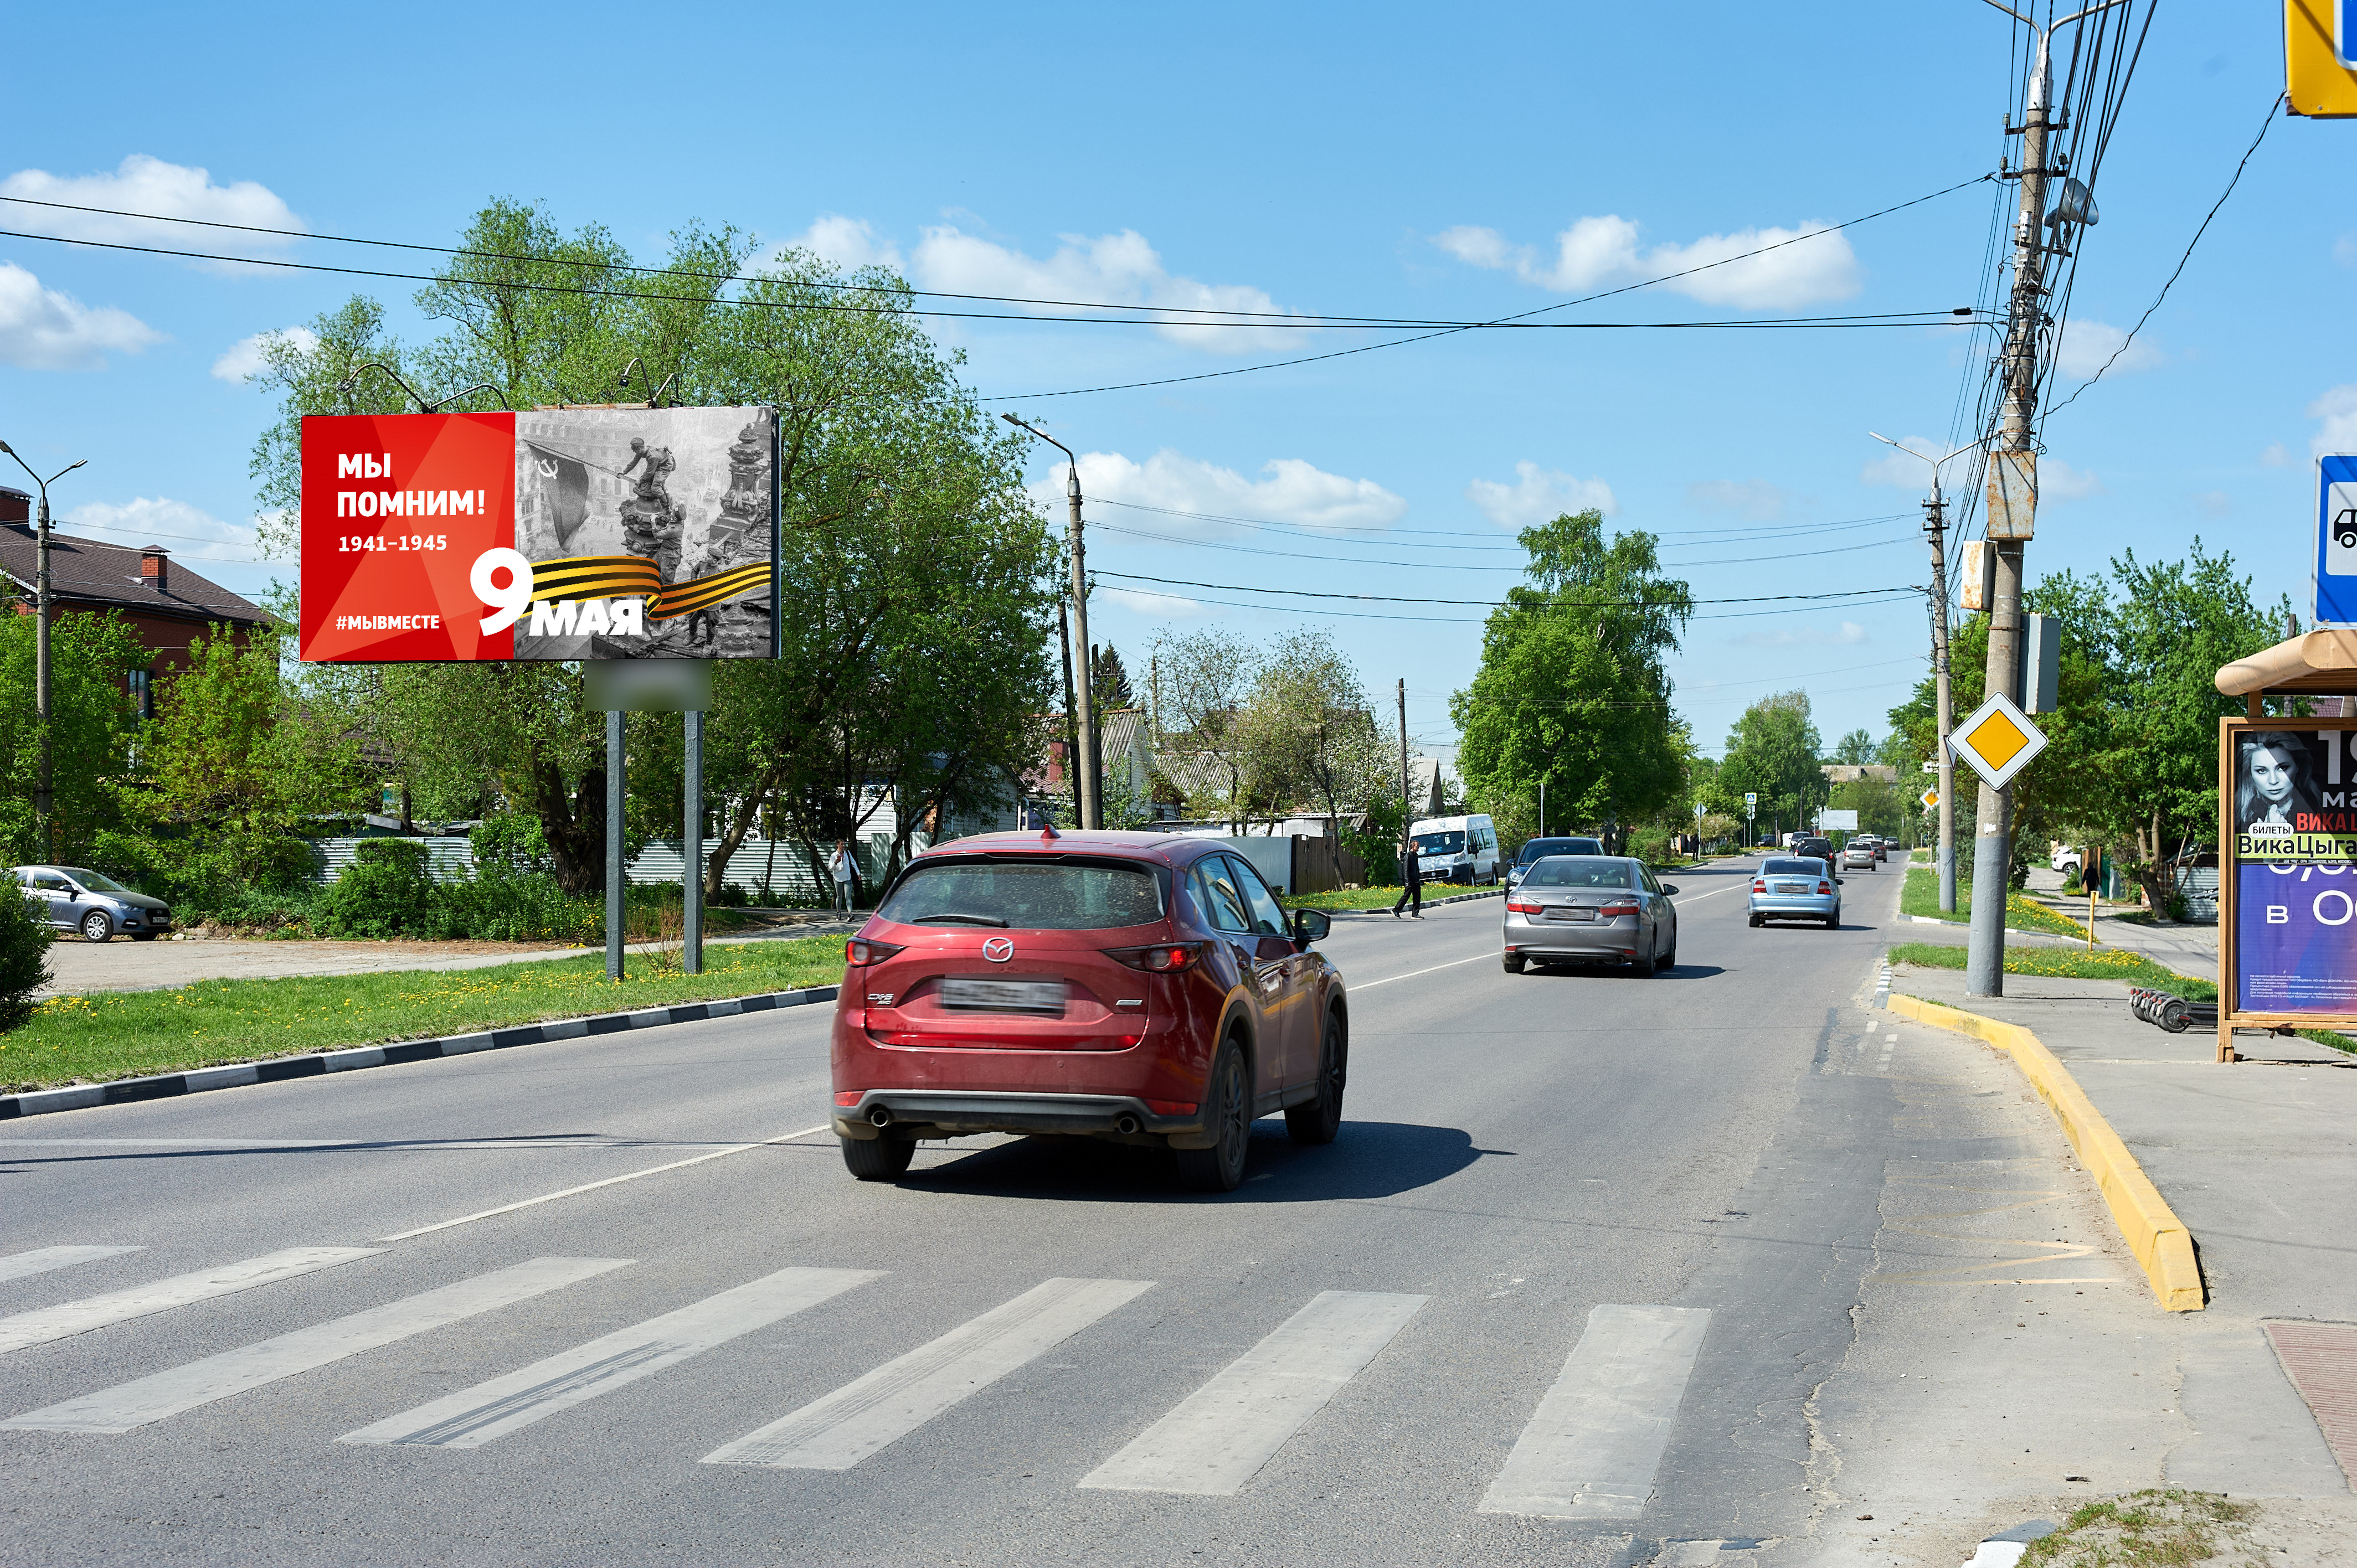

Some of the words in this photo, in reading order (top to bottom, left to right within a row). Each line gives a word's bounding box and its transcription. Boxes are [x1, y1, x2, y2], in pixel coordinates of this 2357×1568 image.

[338, 453, 391, 478] МЫ
[337, 489, 485, 517] ПОМНИМ!
[470, 548, 534, 636] 9
[529, 599, 643, 636] МАЯ
[336, 615, 440, 630] #МЫВМЕСТЕ
[2252, 826, 2291, 834] БИЛЕТЫ
[2296, 812, 2346, 831] ВИКА
[2238, 835, 2357, 858] ВикаЦыга
[2267, 905, 2288, 924] в
[2313, 890, 2357, 926] О
